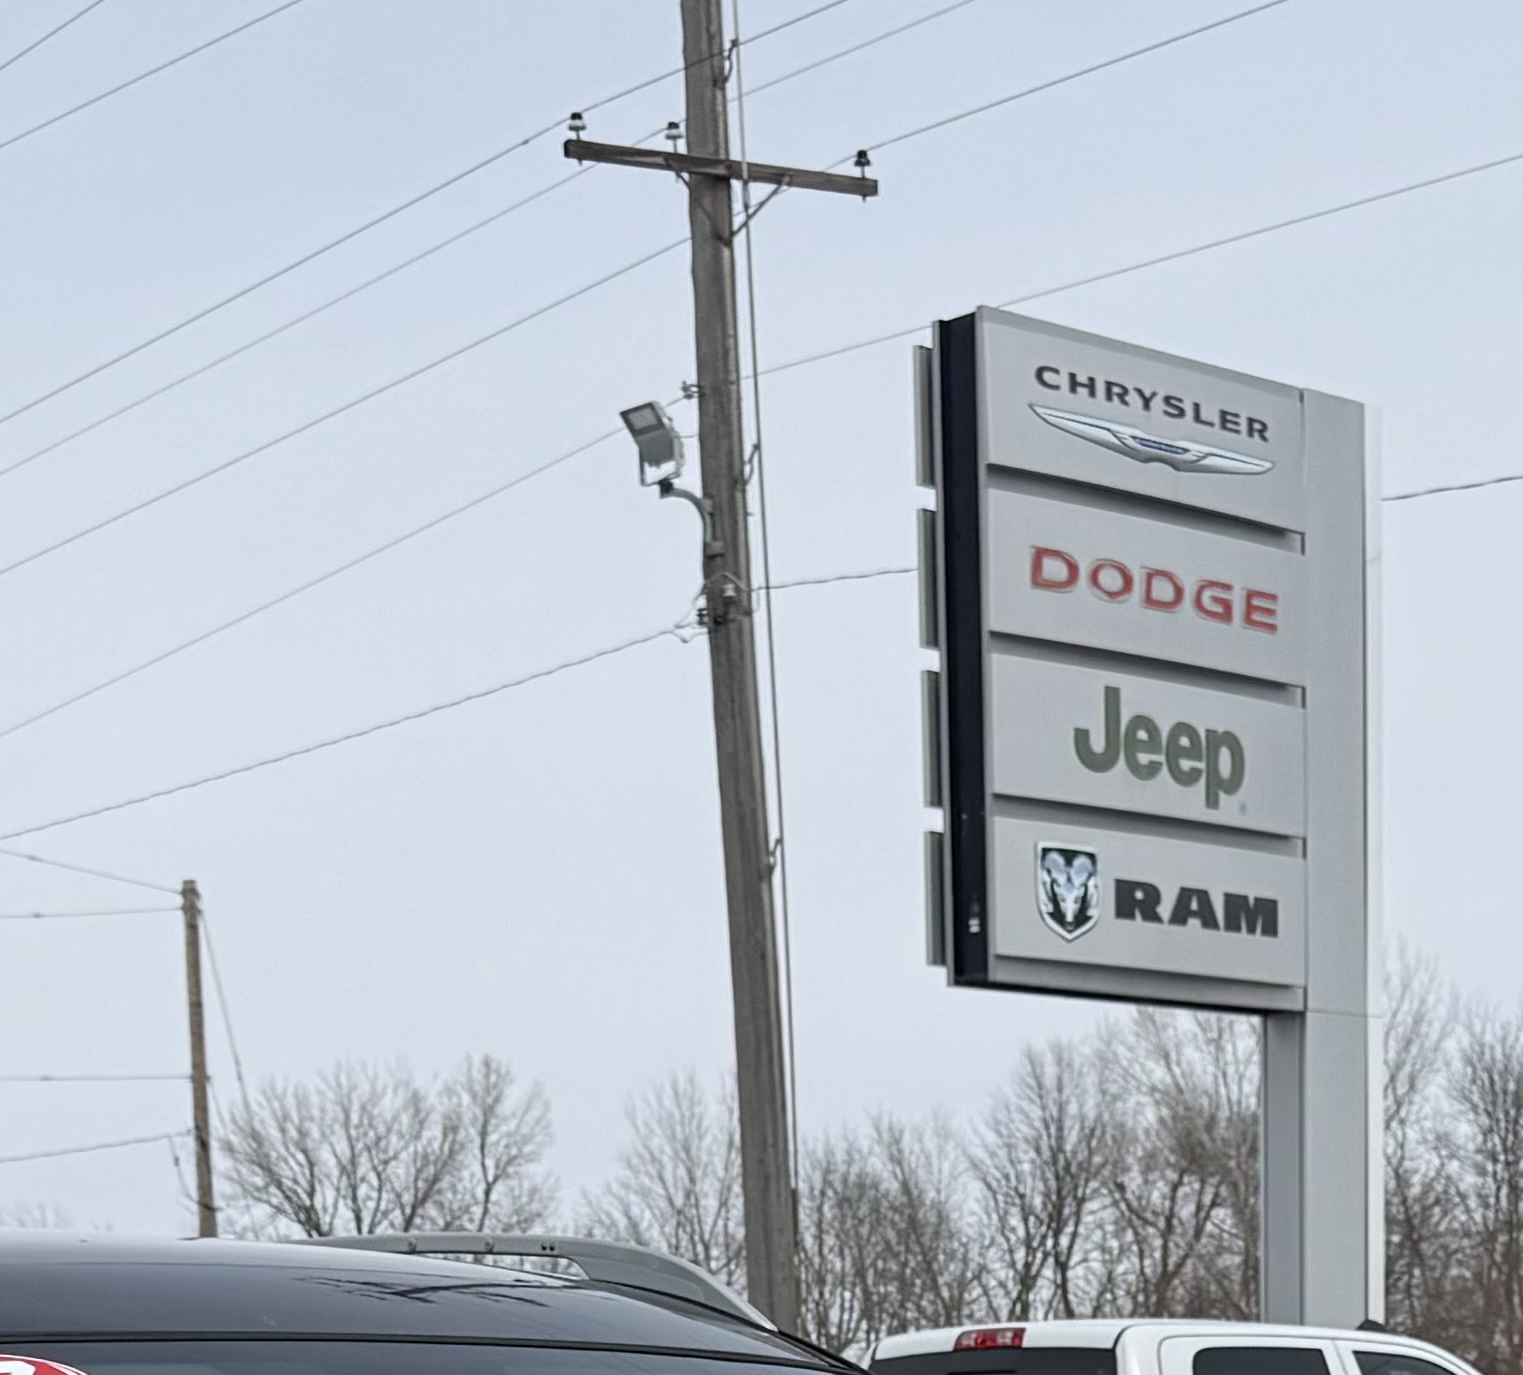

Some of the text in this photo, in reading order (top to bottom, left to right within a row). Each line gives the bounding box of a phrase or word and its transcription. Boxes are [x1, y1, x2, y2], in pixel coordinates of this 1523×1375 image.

[1033, 364, 1270, 443] CHRYSLER
[1029, 544, 1278, 634] DODGE
[1073, 685, 1245, 810] Jeep
[1113, 878, 1279, 939] RAM
